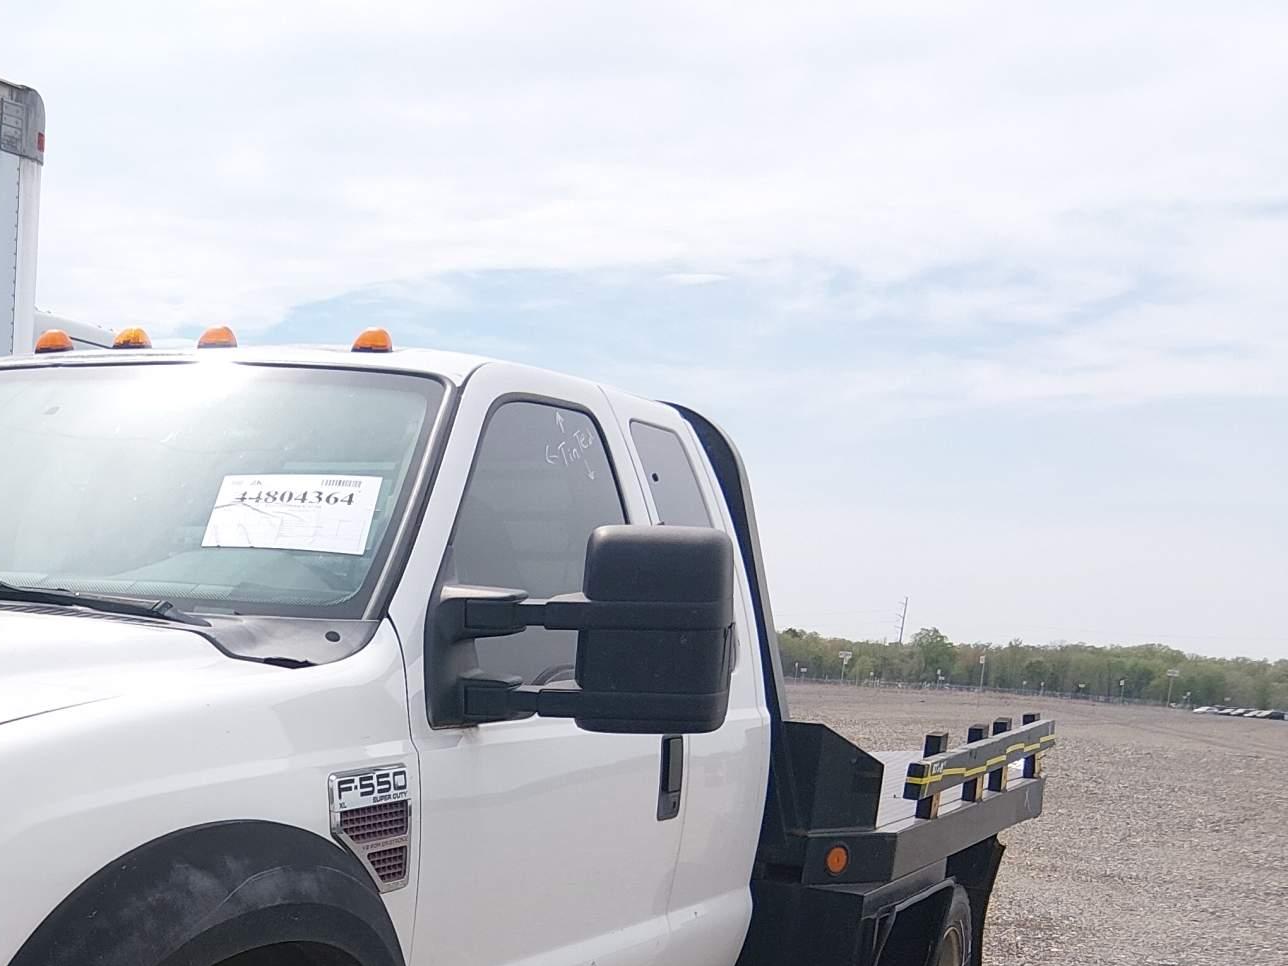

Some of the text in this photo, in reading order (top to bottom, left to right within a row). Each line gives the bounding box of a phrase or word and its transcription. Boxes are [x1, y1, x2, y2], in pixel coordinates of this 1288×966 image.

[233, 490, 355, 506] 44804364
[338, 770, 407, 800] F-550
[373, 791, 409, 803] SUPER DUTY
